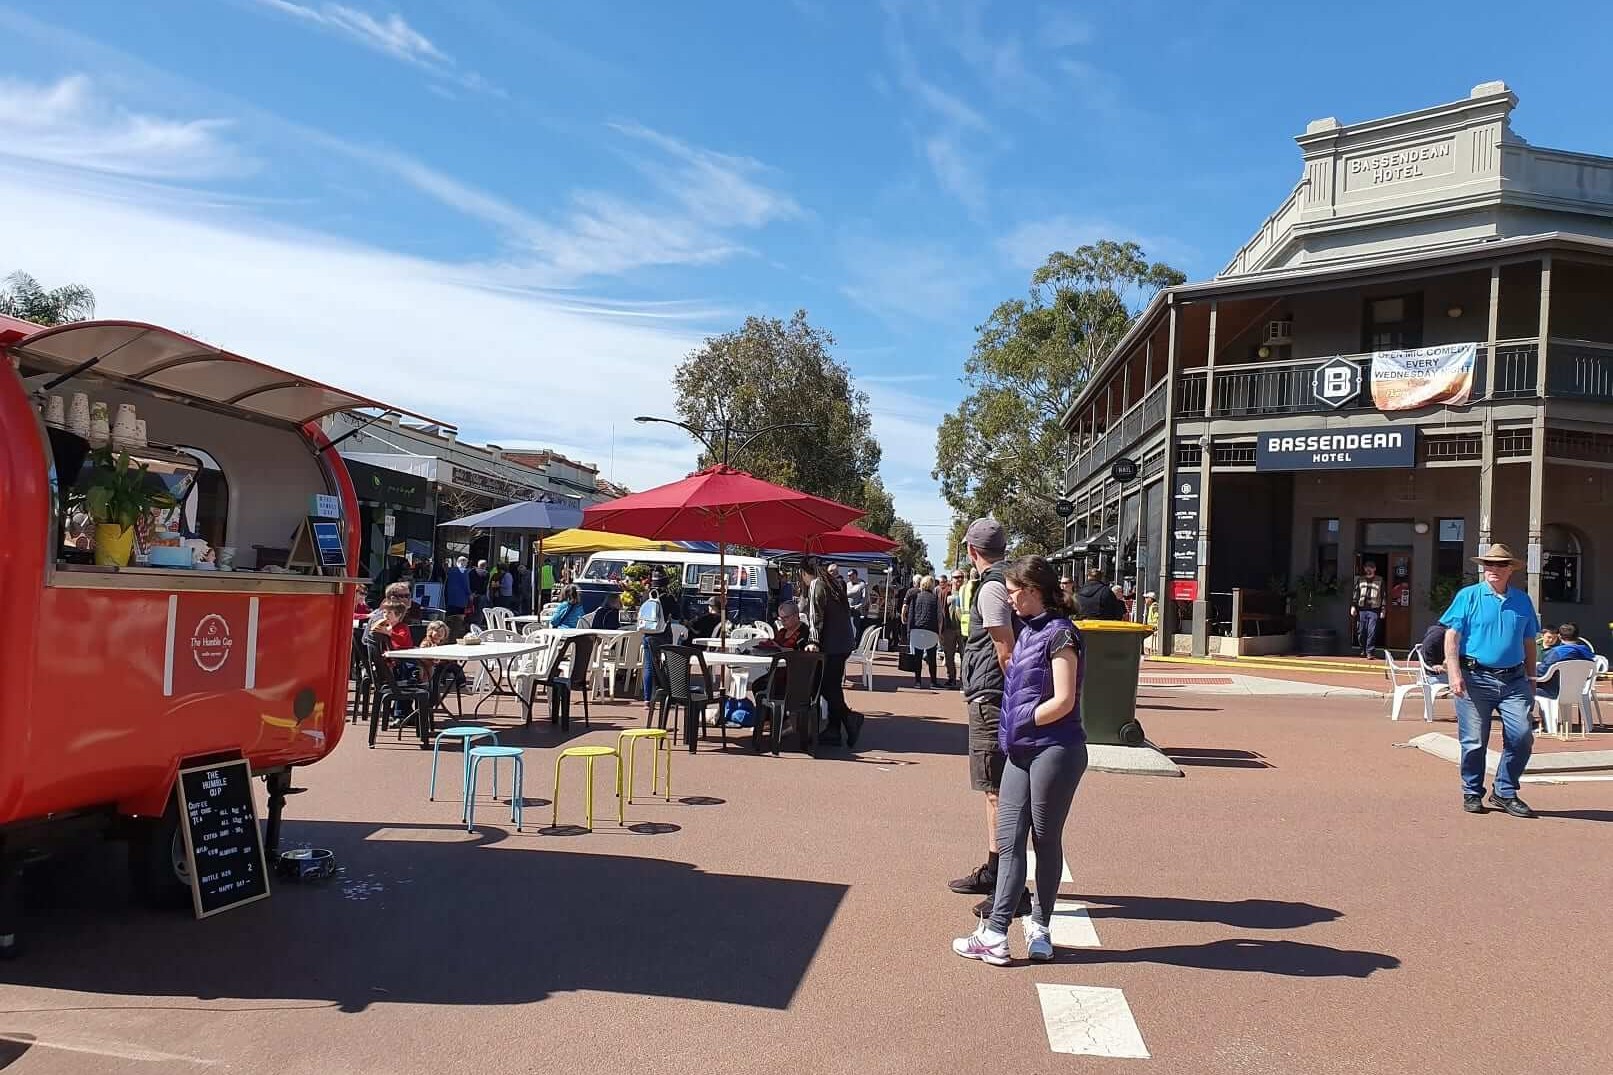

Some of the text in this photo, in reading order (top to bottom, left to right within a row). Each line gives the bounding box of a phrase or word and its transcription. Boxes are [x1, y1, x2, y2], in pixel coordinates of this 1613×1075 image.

[1351, 143, 1450, 173] BASSENDEAN
[1373, 164, 1424, 184] HOTEL
[1377, 344, 1471, 359] OPEN MIC COMEDY
[1406, 358, 1440, 368] EVERY
[1374, 369, 1437, 379] WEDNESDAY
[1323, 366, 1352, 398] B
[1268, 432, 1402, 452] BASSENDEAN
[1312, 453, 1352, 463] HOTEL
[191, 637, 233, 648] The Humble Cup
[207, 771, 219, 779] THE
[202, 777, 228, 790] HUMBLE
[210, 788, 221, 796] CUP
[219, 884, 233, 892] HAPPY
